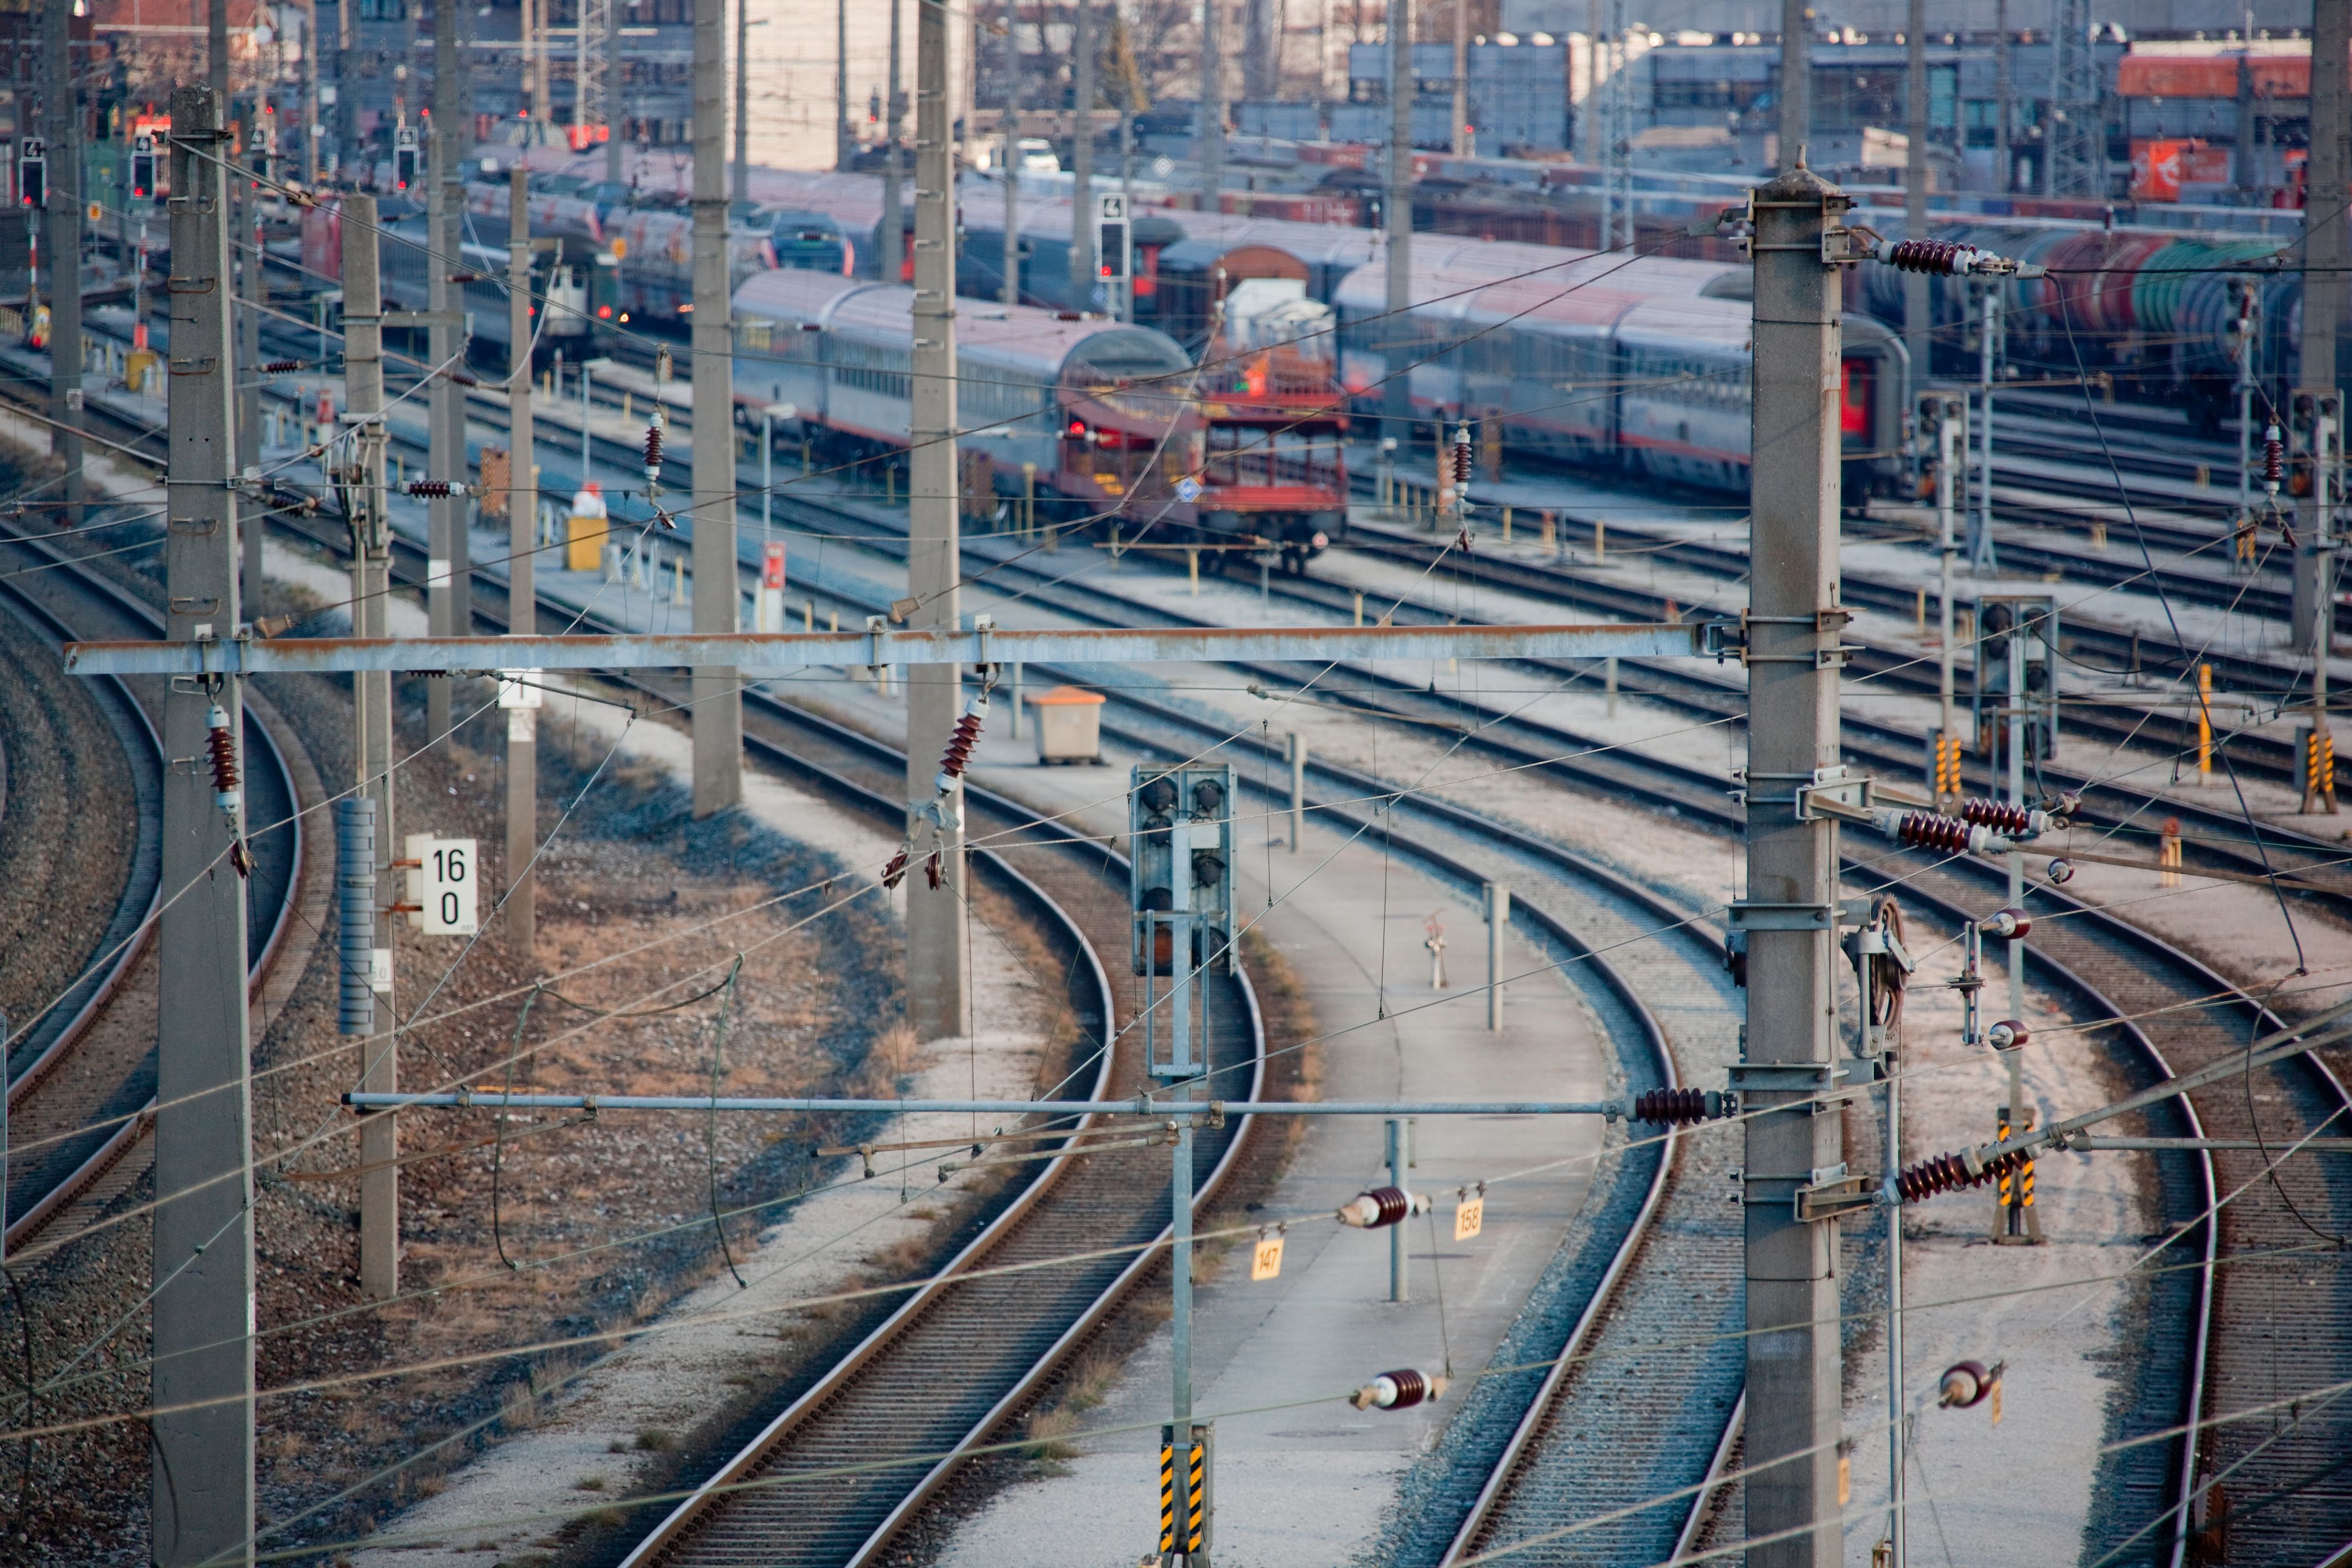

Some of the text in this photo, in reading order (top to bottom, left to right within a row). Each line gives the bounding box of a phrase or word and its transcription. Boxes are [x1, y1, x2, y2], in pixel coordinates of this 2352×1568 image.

[433, 848, 465, 882] 16
[442, 891, 459, 925] 0
[1461, 1206, 1479, 1233] 158
[1258, 1247, 1279, 1272] 147
